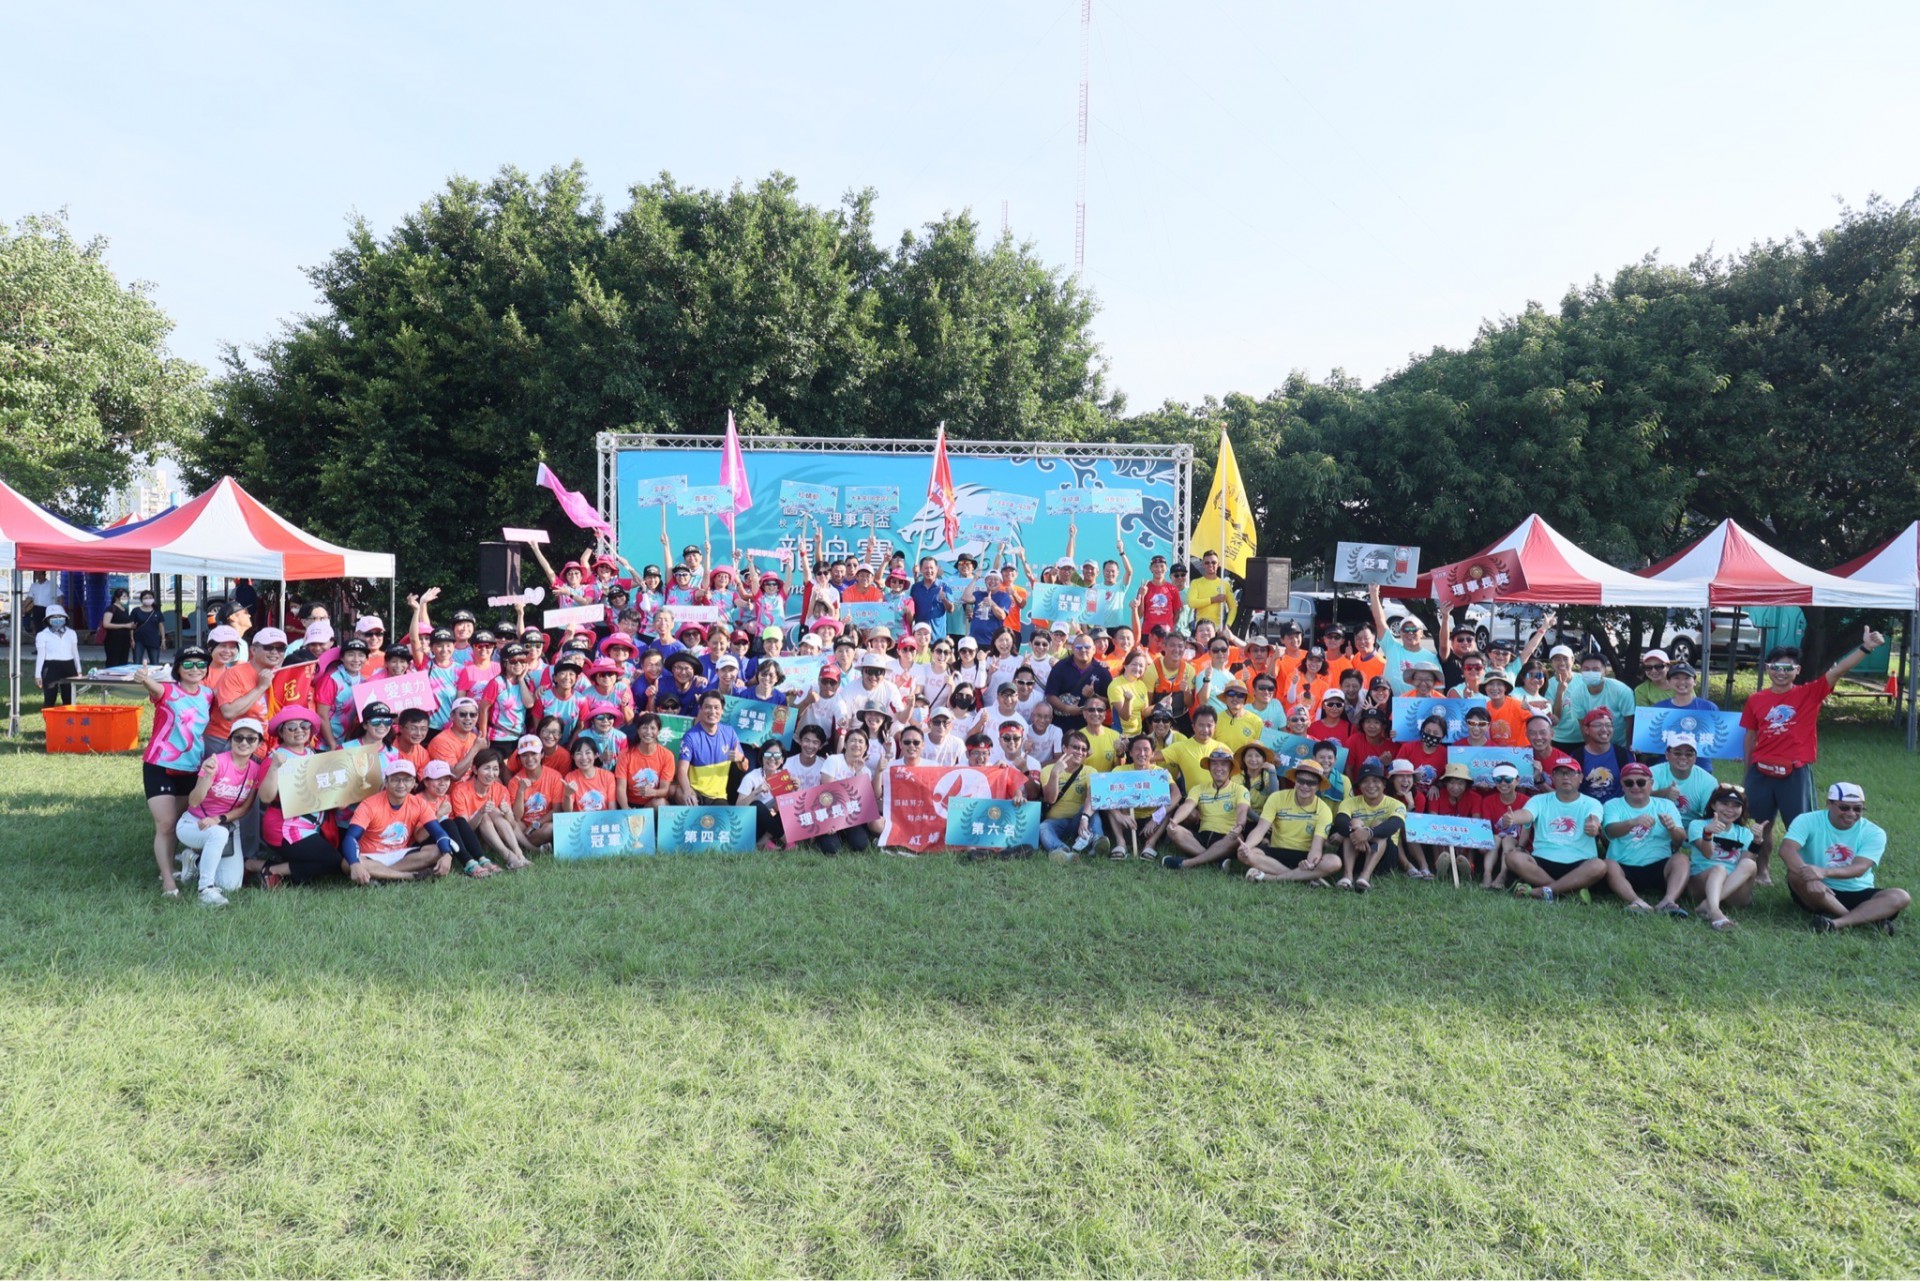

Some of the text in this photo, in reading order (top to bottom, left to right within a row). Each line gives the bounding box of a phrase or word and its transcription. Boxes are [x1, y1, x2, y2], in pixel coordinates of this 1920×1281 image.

[828, 511, 890, 528] 理事長盃
[778, 534, 893, 575] 龍舟賽
[1451, 572, 1510, 597] 理事長獎
[1058, 601, 1081, 611] 亞軍
[283, 680, 301, 701] 冠
[384, 680, 426, 700] 愛美力
[736, 718, 765, 732] 季軍
[315, 769, 348, 789] 冠軍
[799, 800, 862, 827] 理事長獎
[590, 824, 621, 834] 班級組
[684, 830, 731, 844] 第四名
[971, 821, 1017, 838] 第六名
[590, 833, 621, 849] 冠軍
